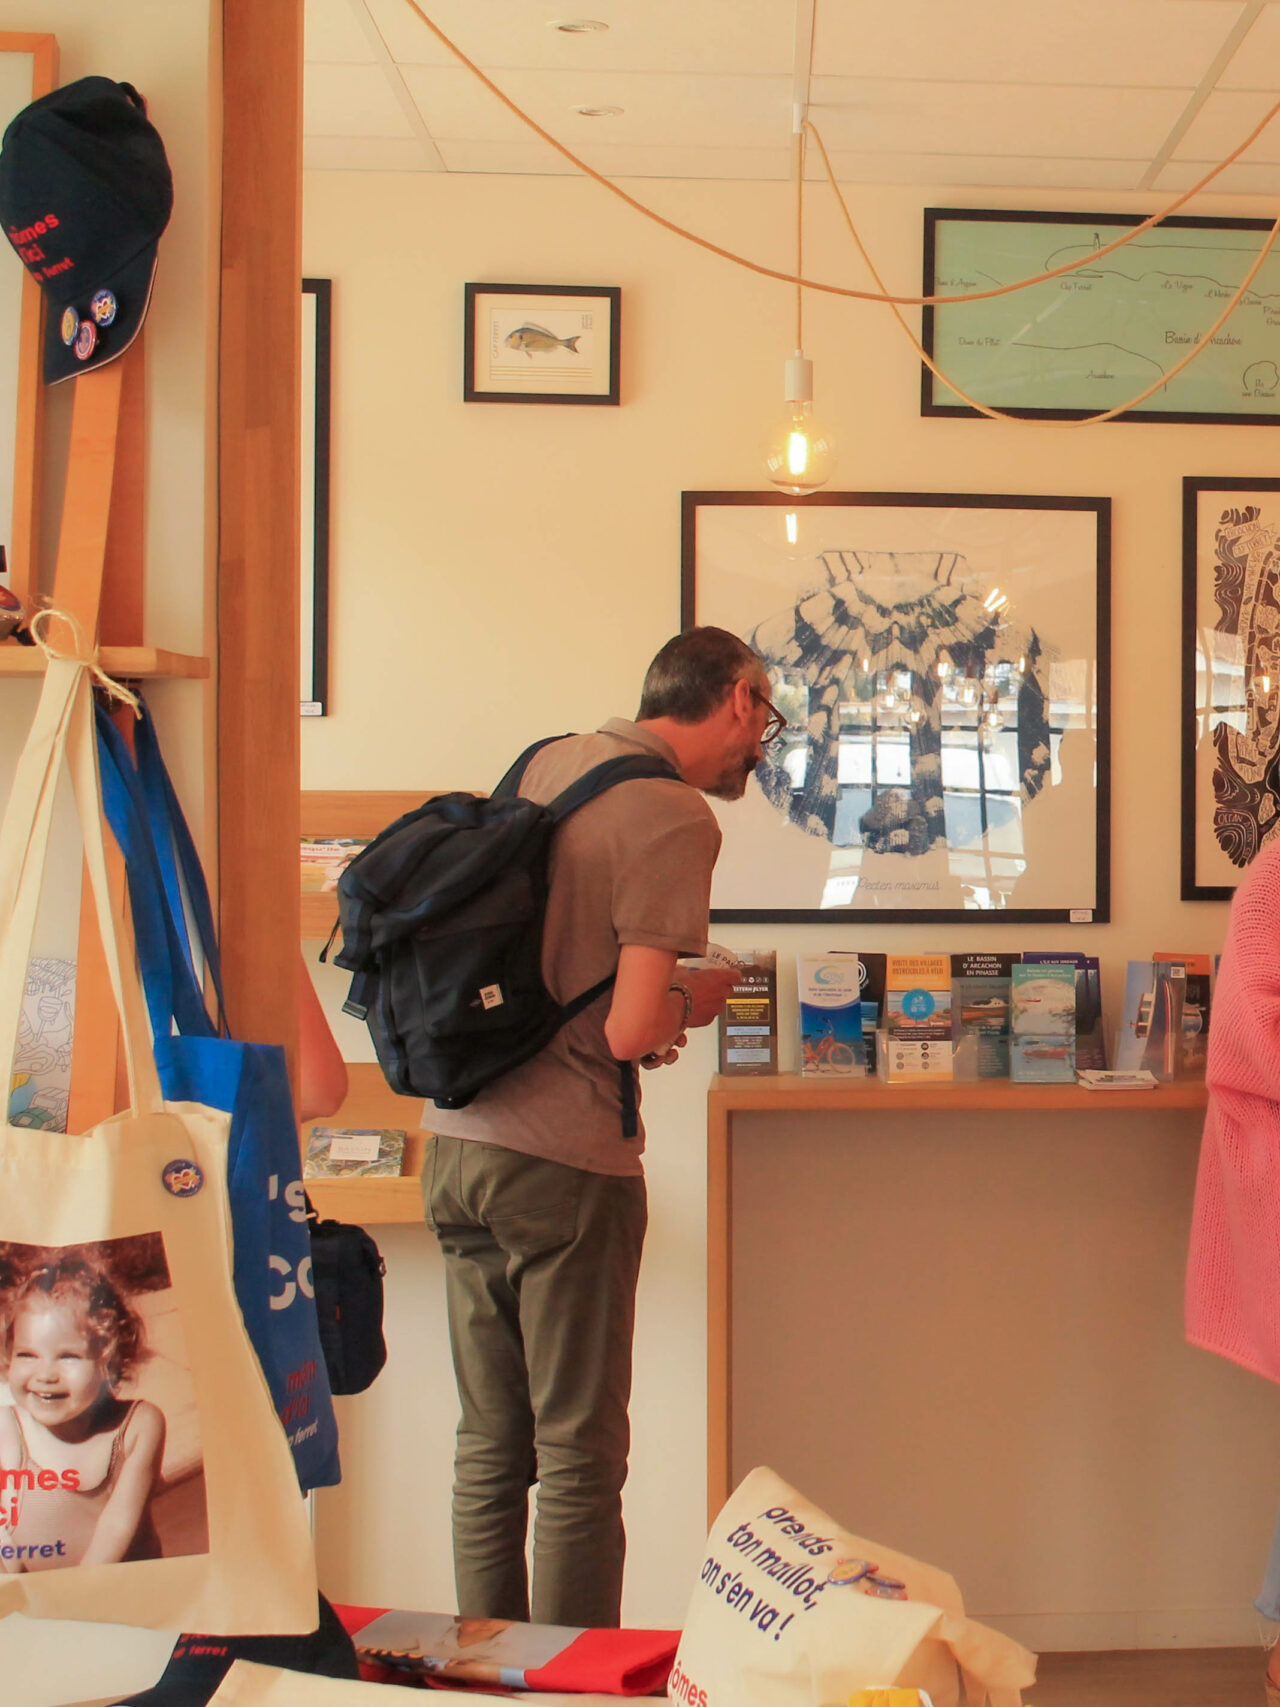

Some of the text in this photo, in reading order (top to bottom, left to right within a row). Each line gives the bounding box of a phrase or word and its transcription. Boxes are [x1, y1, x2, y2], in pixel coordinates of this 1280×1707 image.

[1165, 330, 1191, 345] Bassin
[0, 1468, 81, 1491] mes
[0, 1540, 66, 1559] erret
[757, 1506, 836, 1556] prends
[727, 1521, 828, 1611] ton maillot,
[701, 1557, 795, 1641] on s'en va !
[670, 1659, 708, 1707] ômes
